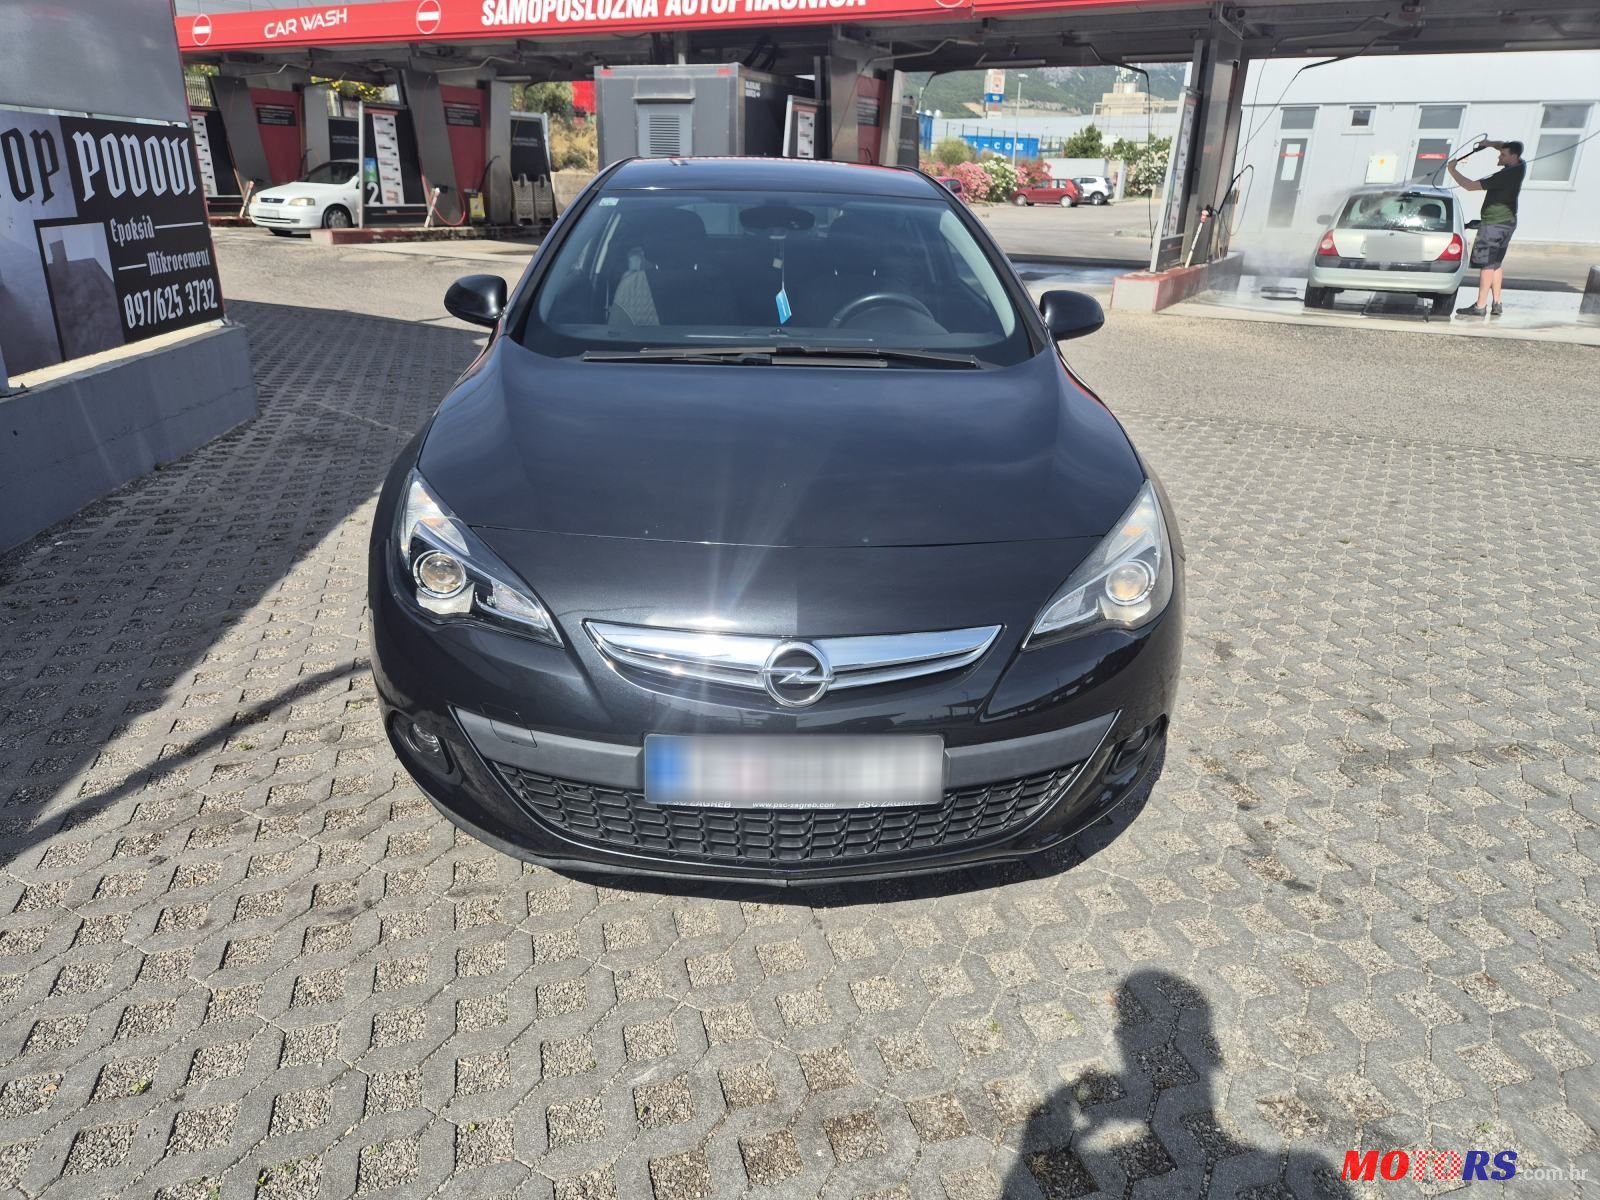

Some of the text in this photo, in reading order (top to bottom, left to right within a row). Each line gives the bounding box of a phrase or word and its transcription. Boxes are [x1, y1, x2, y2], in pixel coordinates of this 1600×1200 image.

[264, 7, 348, 39] CAR WASH
[0, 127, 60, 206] OP
[367, 182, 381, 205] 2
[110, 215, 155, 247] Epoksid
[147, 248, 211, 277] Mikrocement
[123, 277, 218, 329] 097/625 3732
